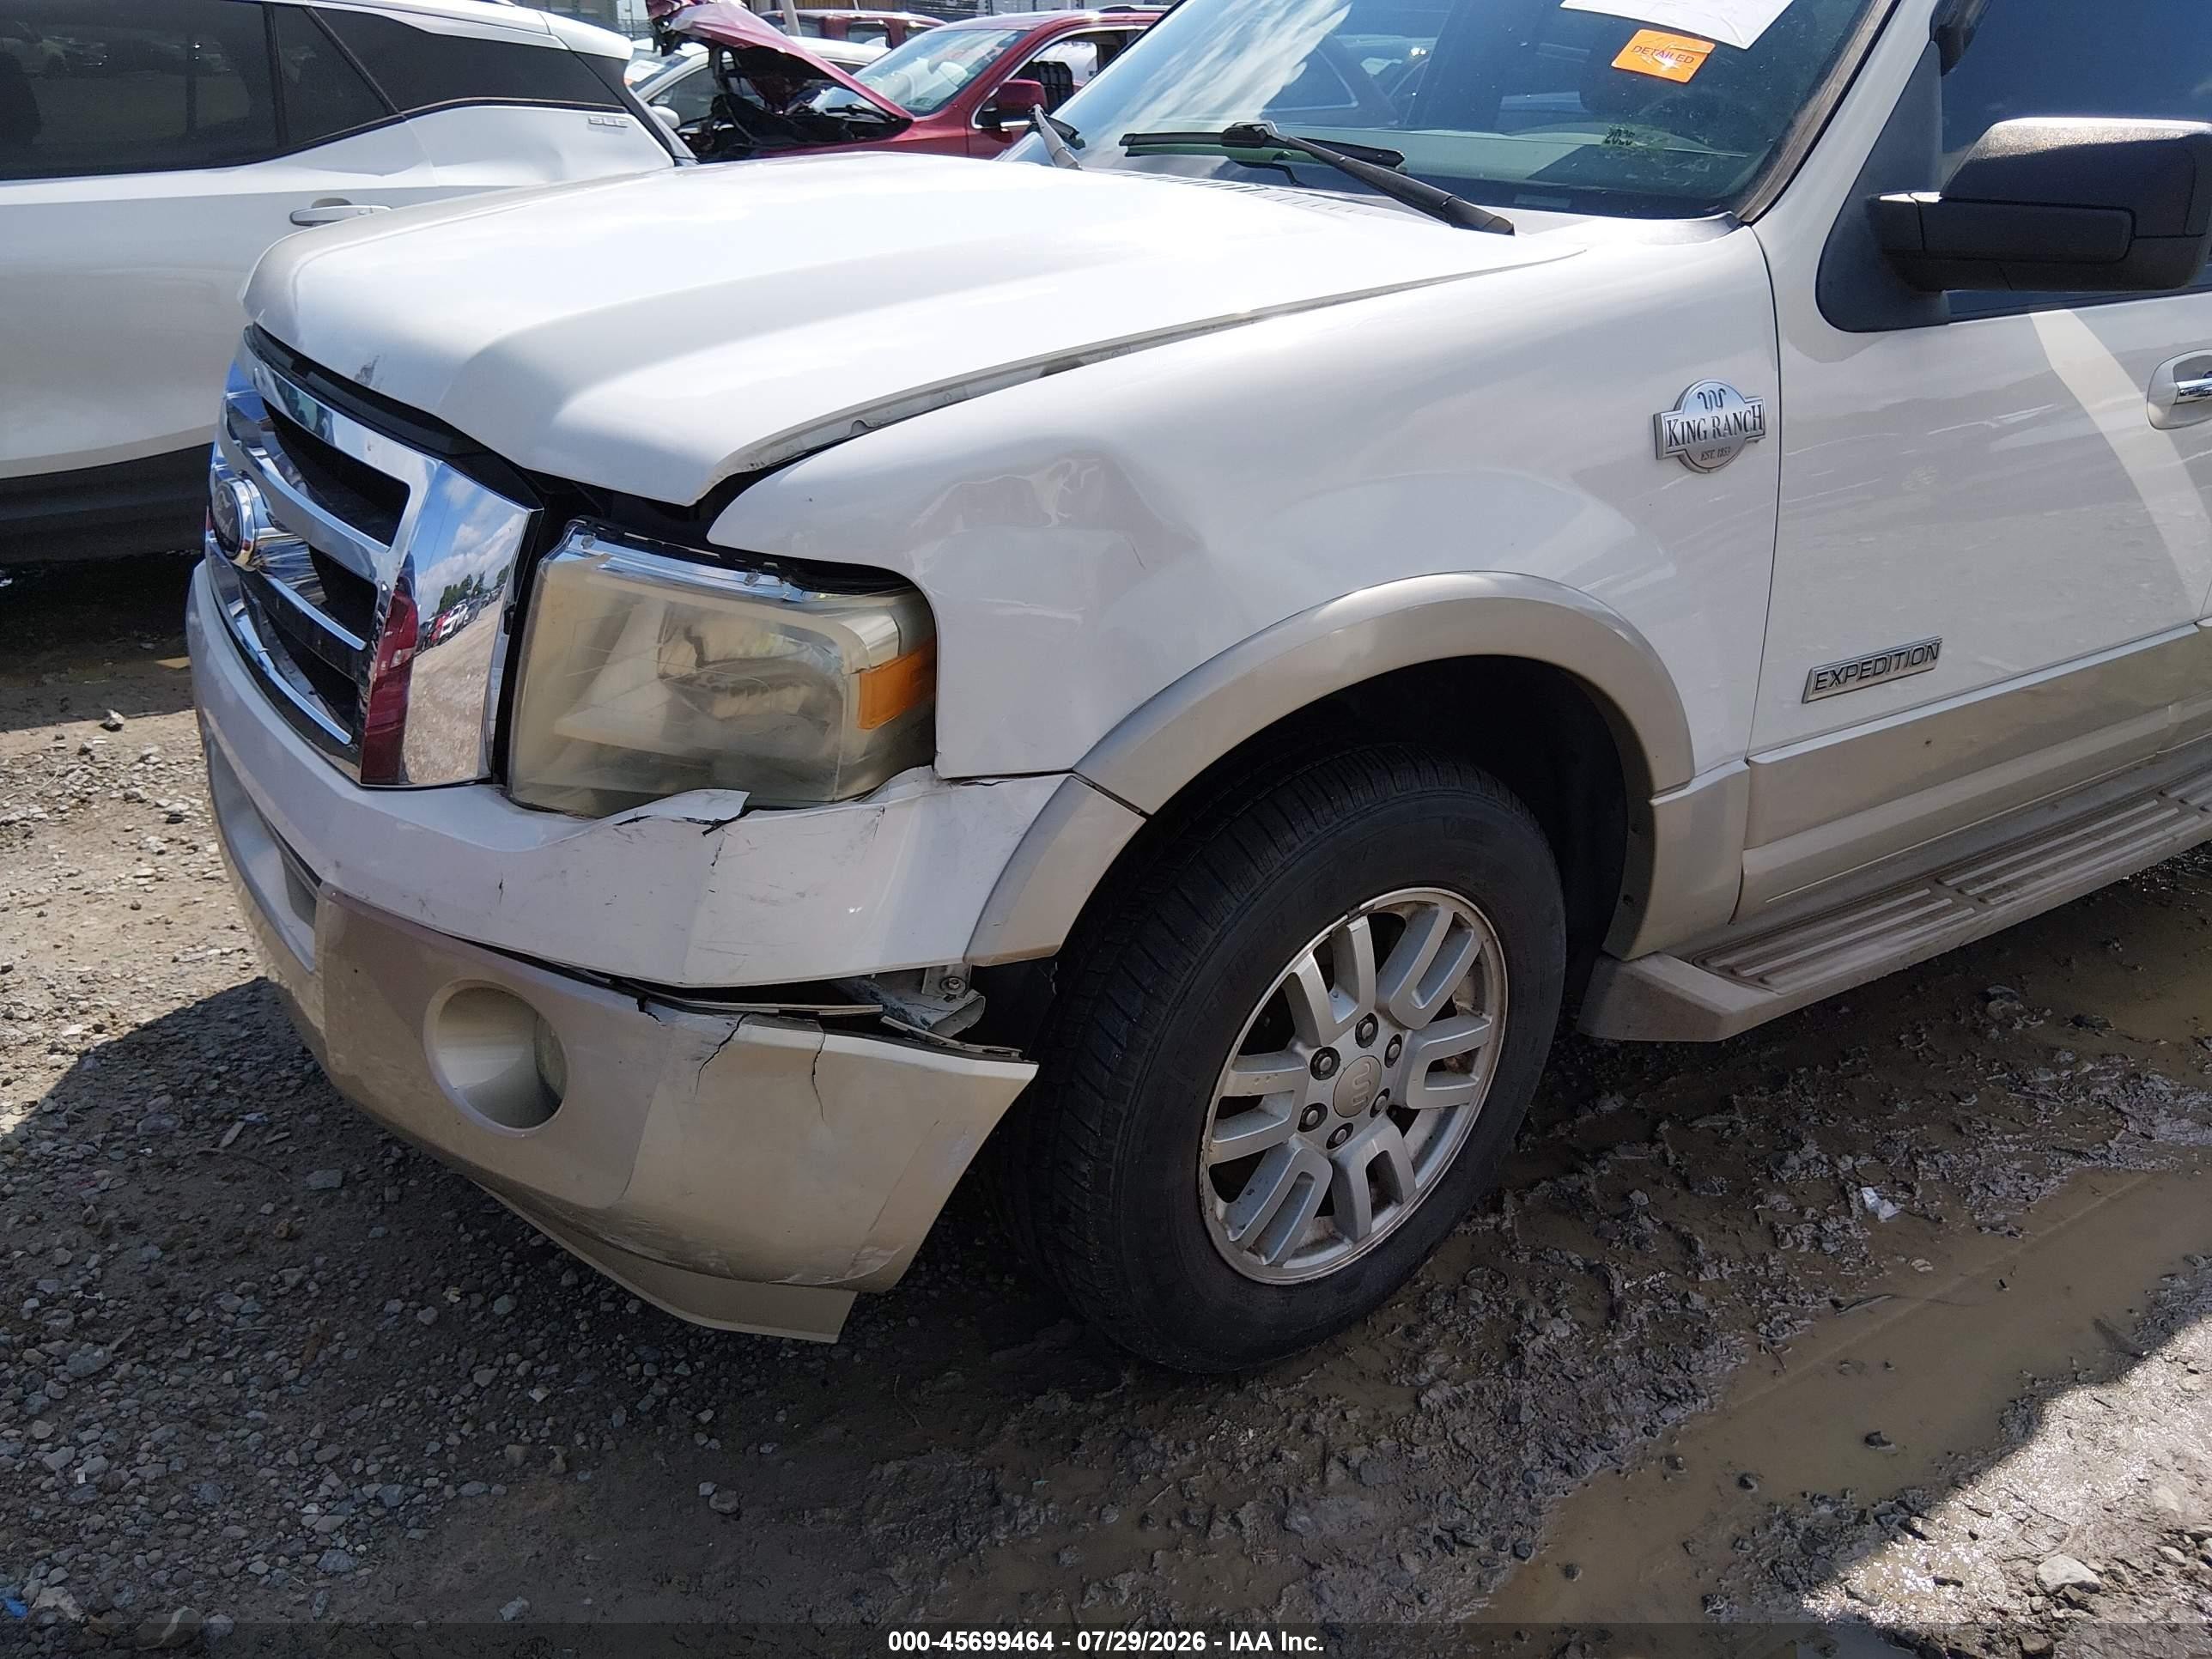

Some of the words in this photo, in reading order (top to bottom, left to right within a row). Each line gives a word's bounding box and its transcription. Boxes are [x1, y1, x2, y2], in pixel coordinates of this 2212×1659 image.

[1632, 46, 1695, 64] DETAILED
[587, 116, 629, 128] SLE
[1666, 418, 1707, 447] KING
[1711, 404, 1763, 440] RANCH
[1814, 642, 1941, 690] EXPEDITION
